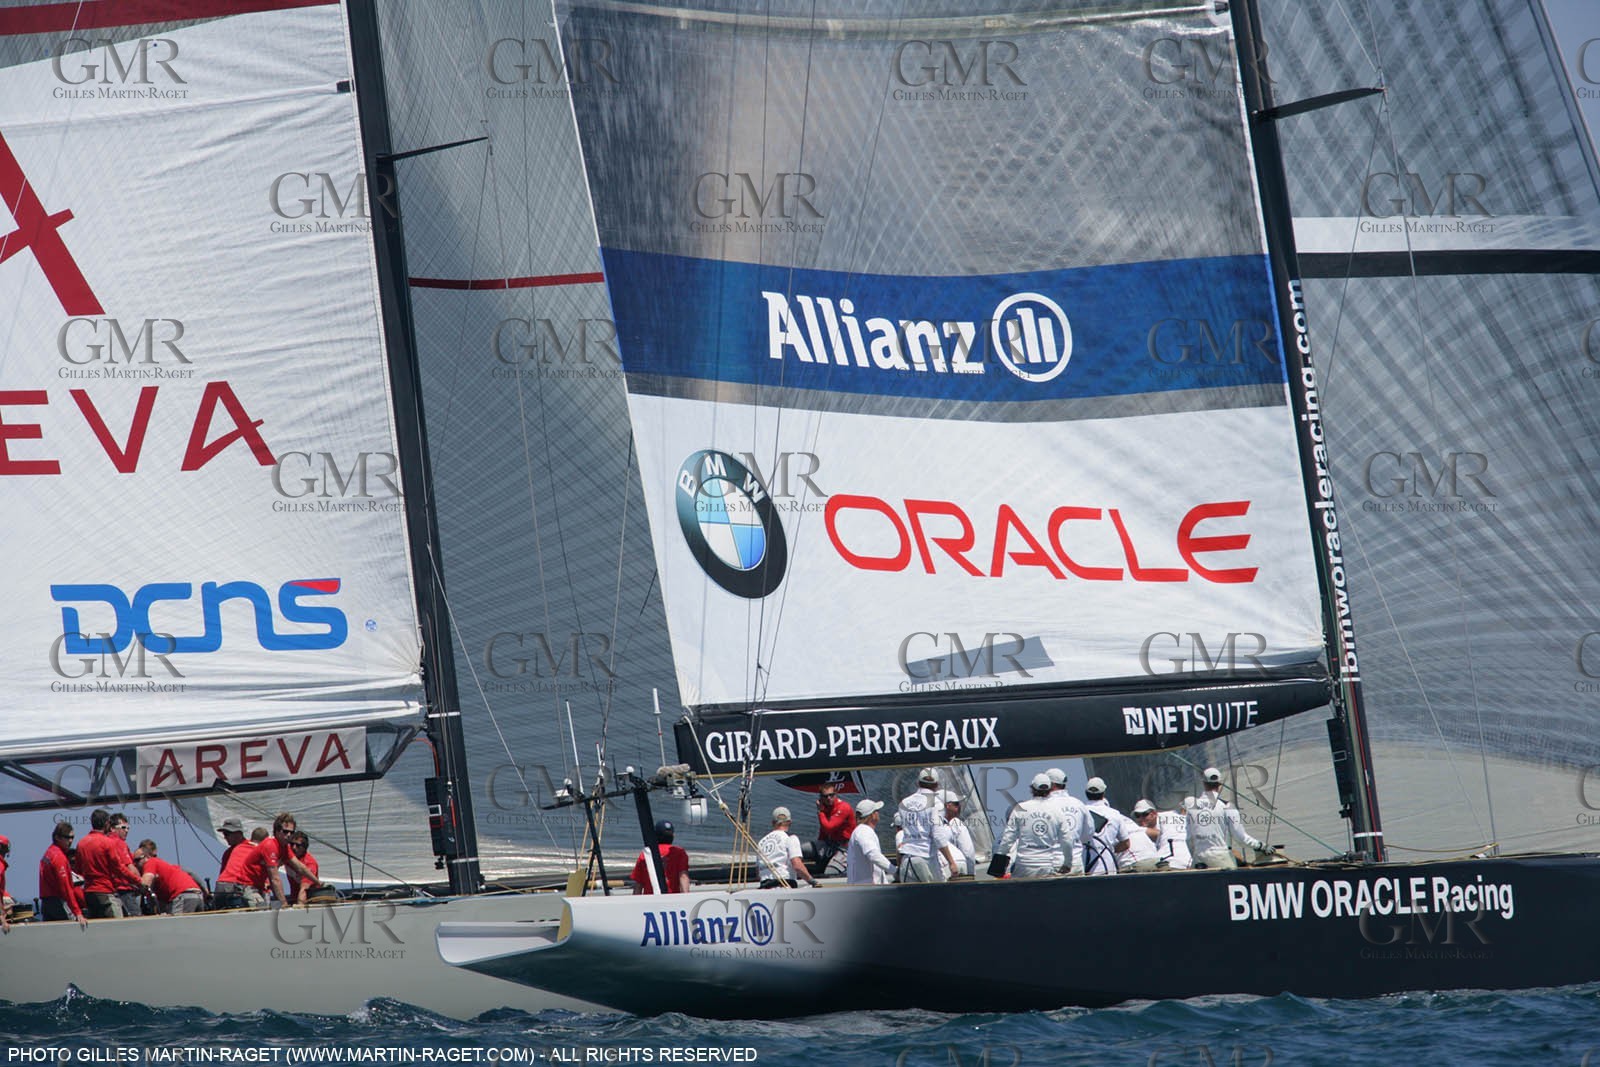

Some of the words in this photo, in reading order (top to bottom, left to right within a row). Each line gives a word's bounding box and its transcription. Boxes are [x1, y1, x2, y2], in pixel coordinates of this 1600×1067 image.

[762, 290, 984, 374] Allianz
[679, 453, 765, 504] BMW
[1288, 279, 1358, 673] bmworacleracing.com
[824, 494, 1259, 584] ORACLE
[705, 716, 1001, 765] GIRARD-PERREGAUX
[1145, 700, 1259, 735] NETSUITE
[151, 732, 352, 788] AREVA
[1228, 882, 1304, 921] BMW
[1311, 877, 1428, 917] ORACLE
[1432, 874, 1514, 920] Racing
[640, 911, 741, 948] Allianz
